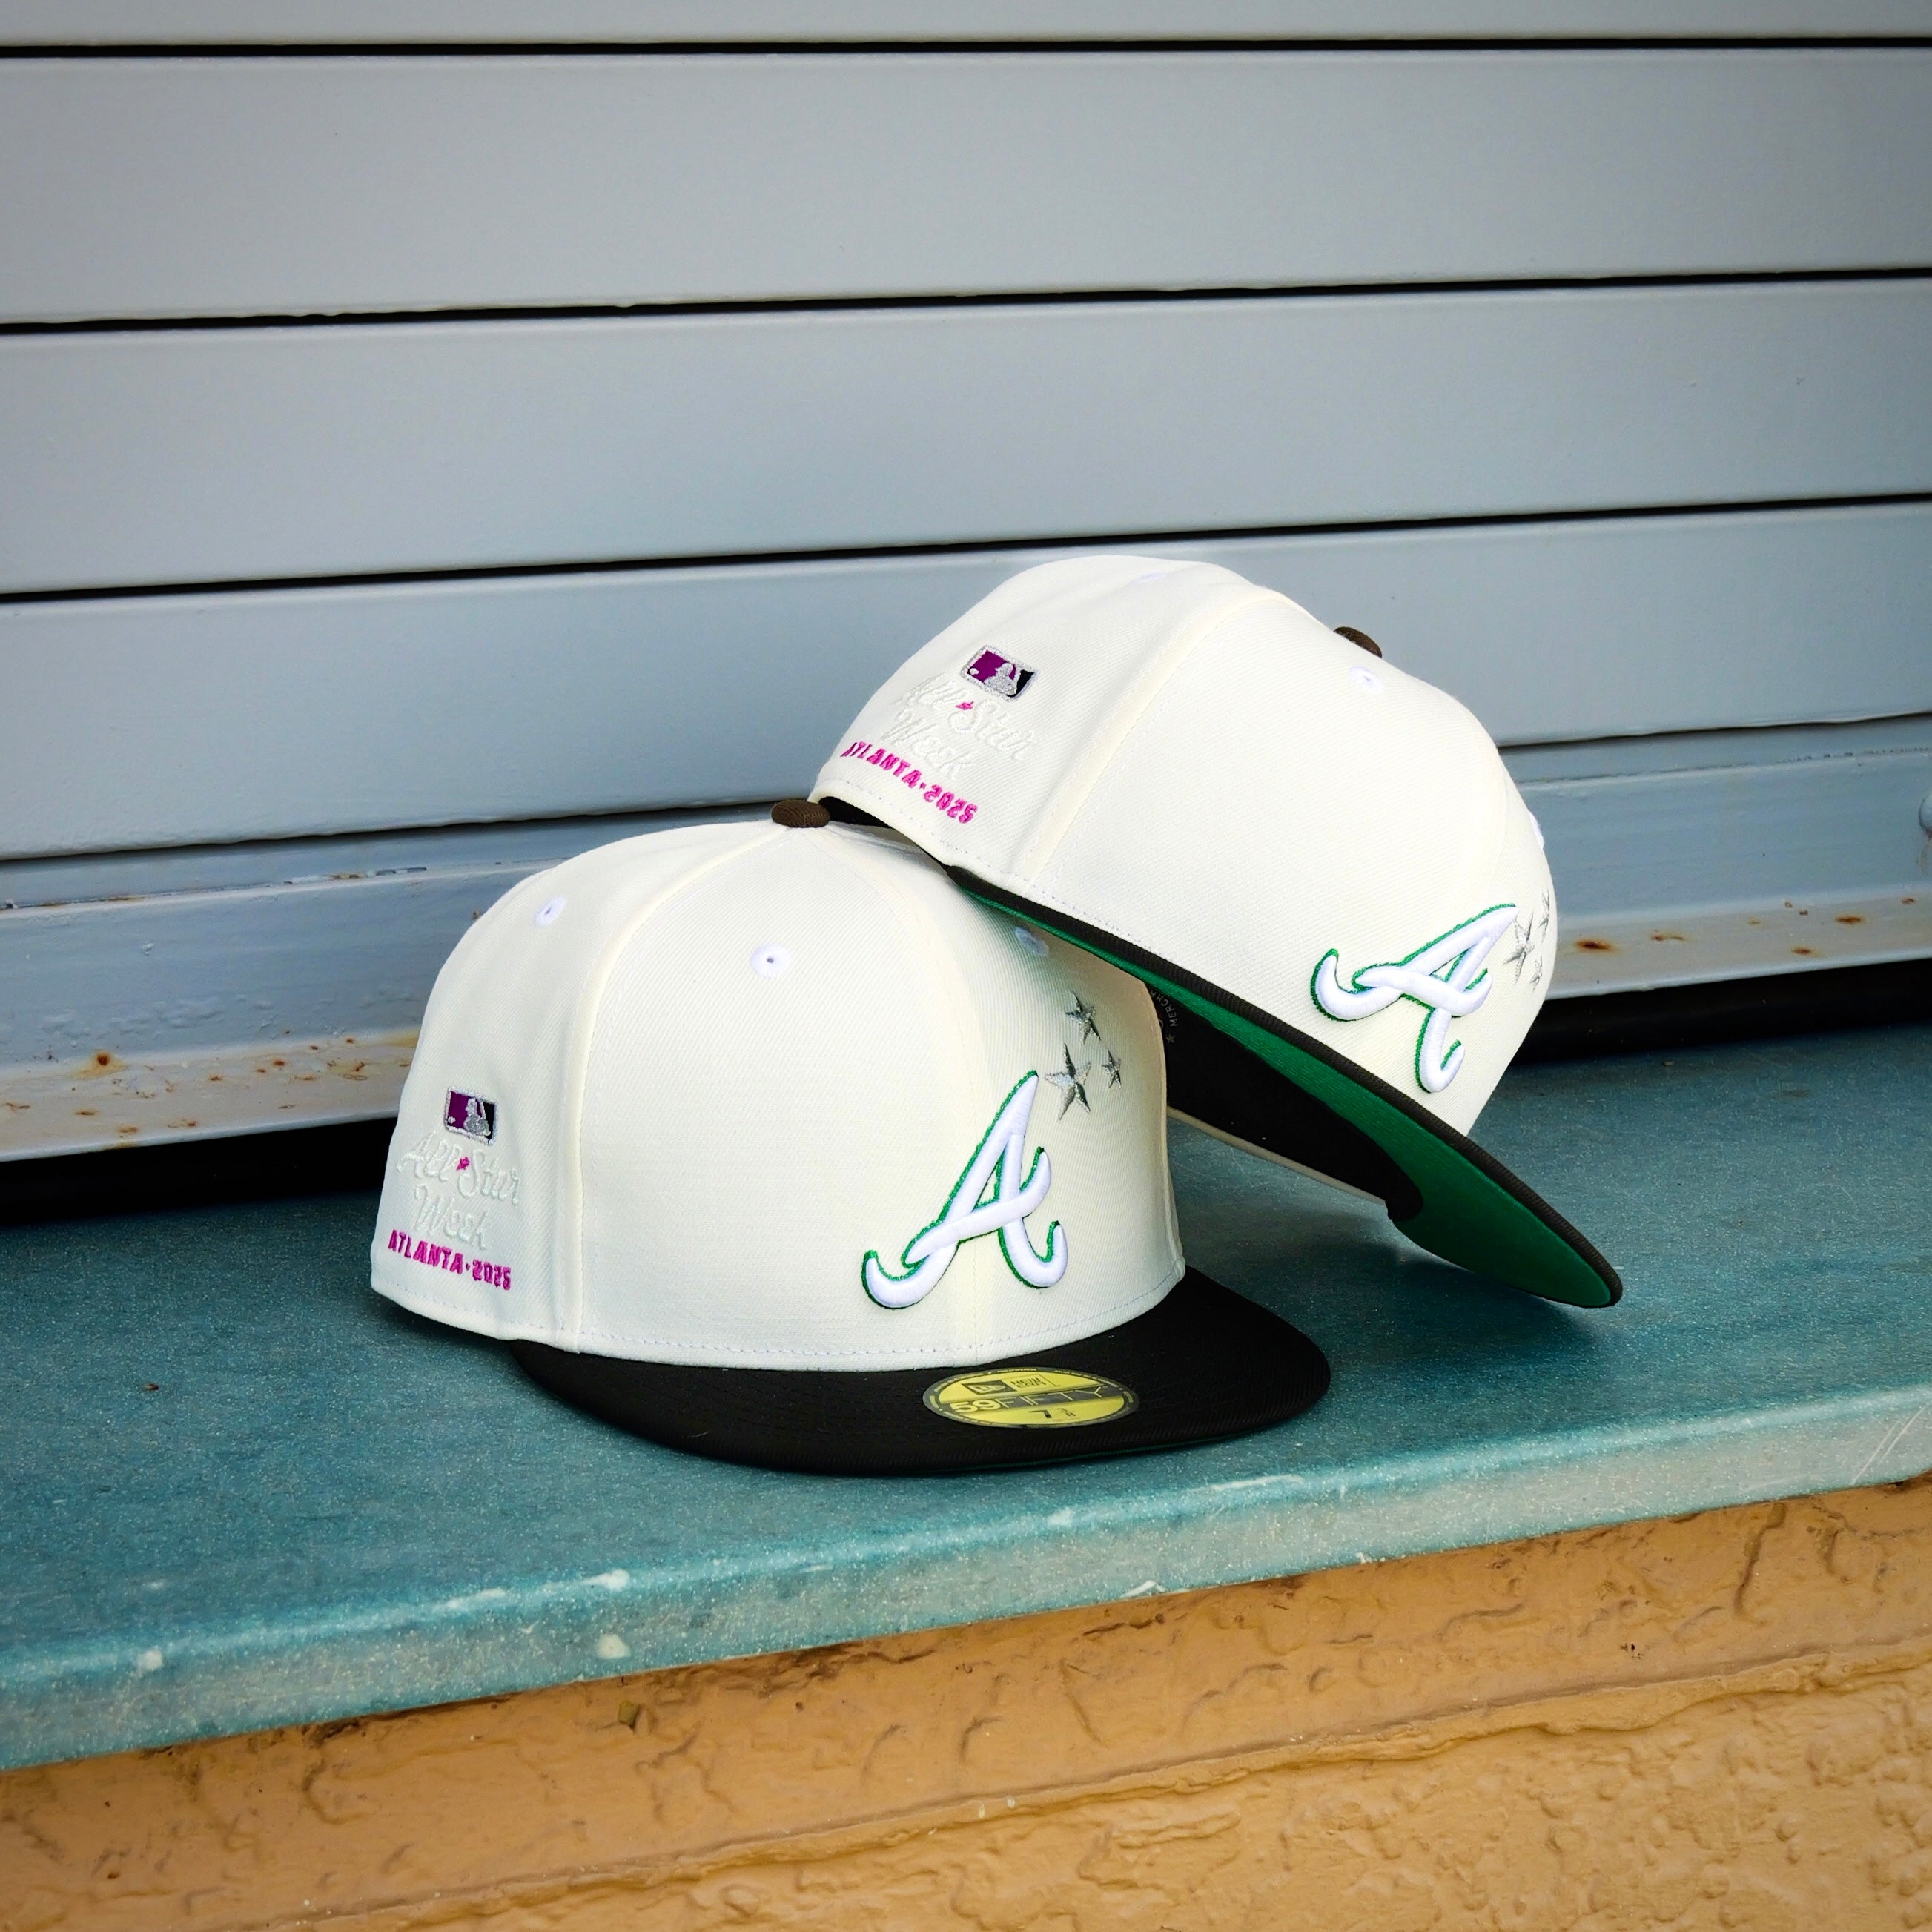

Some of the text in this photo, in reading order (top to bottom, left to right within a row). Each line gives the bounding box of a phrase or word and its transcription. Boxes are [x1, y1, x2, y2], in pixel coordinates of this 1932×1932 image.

[1310, 902, 1518, 1094] A
[457, 1148, 520, 1205] Star
[861, 1070, 1068, 1310] A
[414, 1182, 491, 1251] Week
[950, 1386, 1108, 1413] 59FIFTY
[1028, 1409, 1052, 1418] 7
